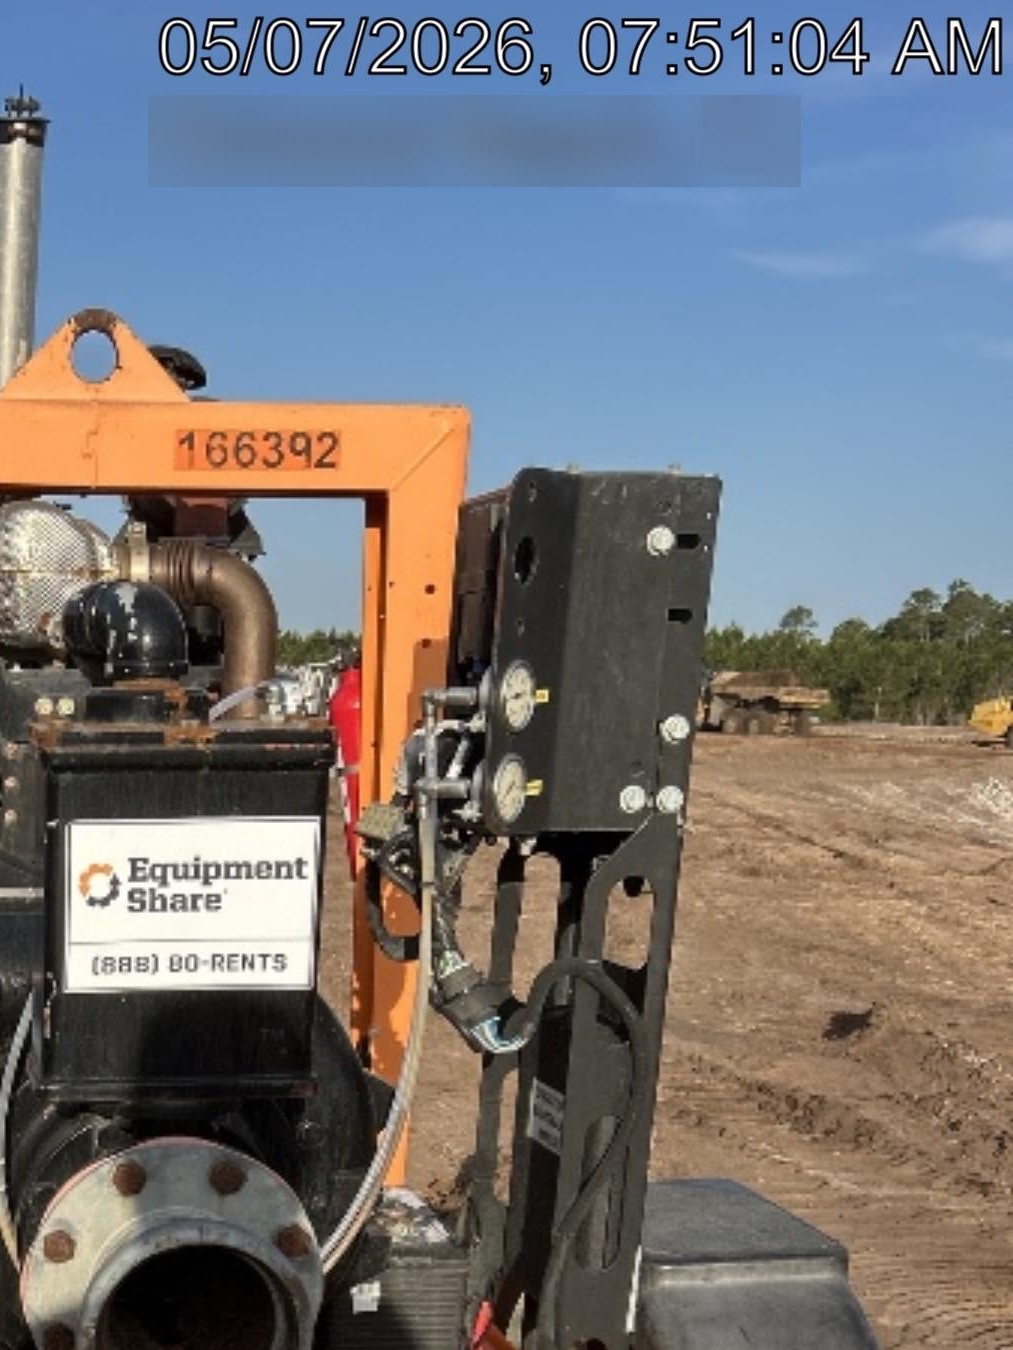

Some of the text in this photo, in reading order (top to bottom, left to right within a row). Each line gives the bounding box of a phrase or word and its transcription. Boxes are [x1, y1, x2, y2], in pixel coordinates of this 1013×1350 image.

[178, 430, 339, 469] 166392
[126, 854, 310, 888] Equipment
[126, 887, 224, 914] Share
[91, 953, 160, 976] (888)
